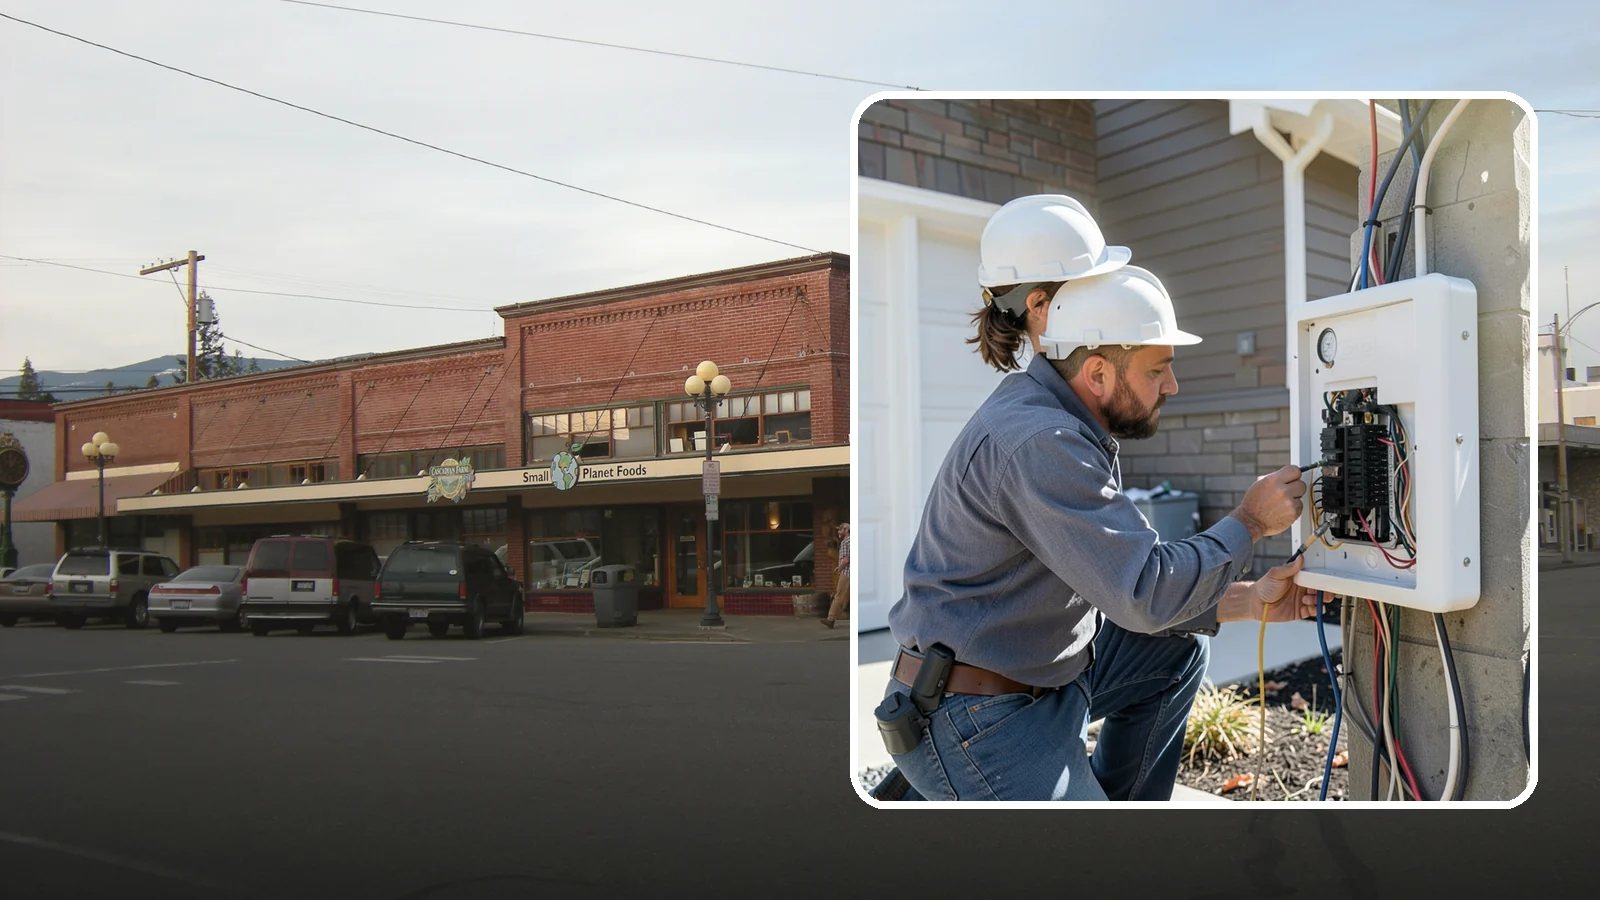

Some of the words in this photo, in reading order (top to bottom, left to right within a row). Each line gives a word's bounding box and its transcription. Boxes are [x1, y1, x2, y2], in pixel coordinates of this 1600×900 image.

[523, 472, 549, 482] Small
[583, 468, 614, 479] Planet
[617, 464, 647, 477] Foods
